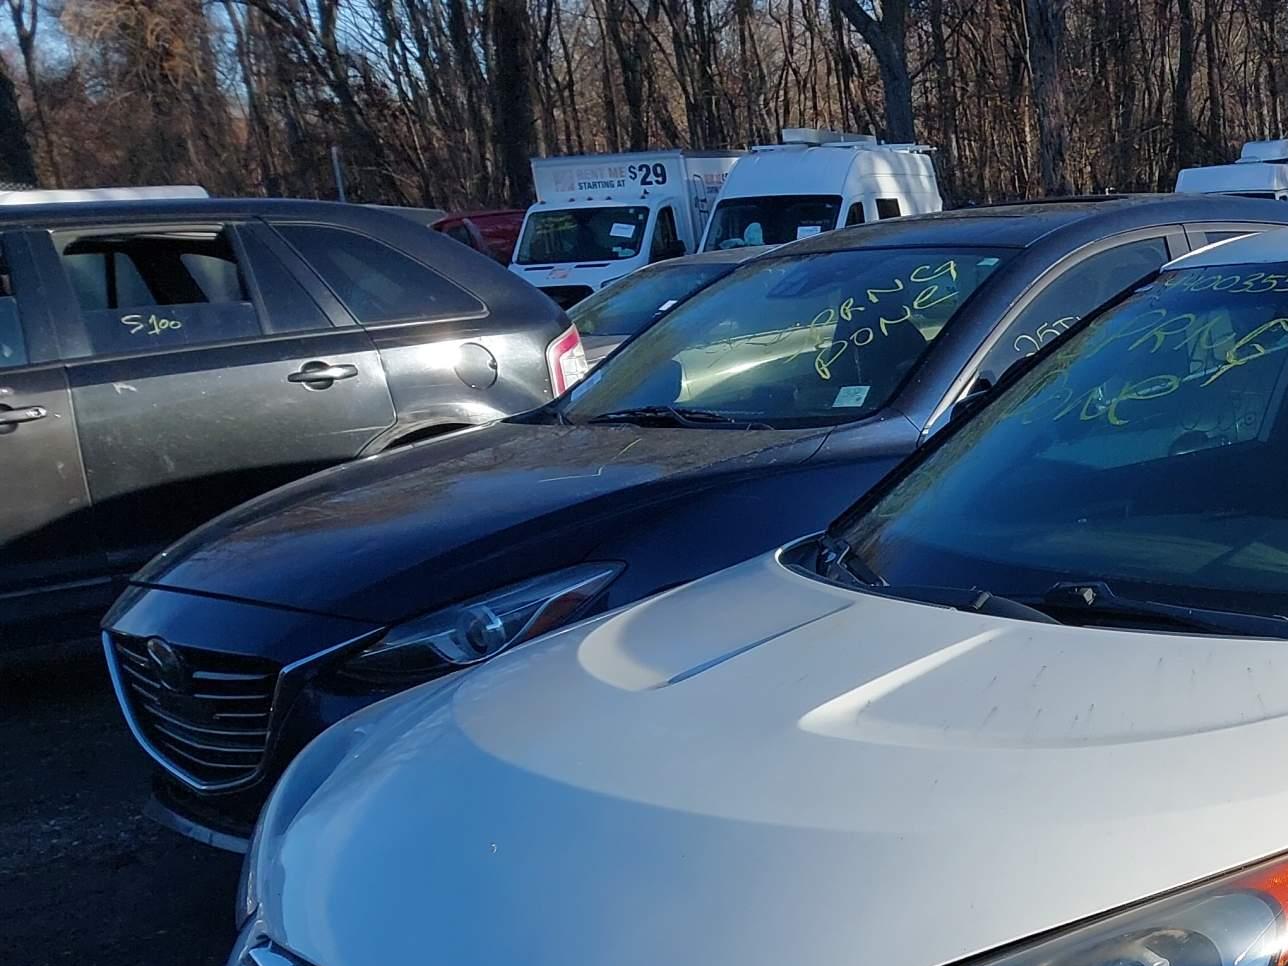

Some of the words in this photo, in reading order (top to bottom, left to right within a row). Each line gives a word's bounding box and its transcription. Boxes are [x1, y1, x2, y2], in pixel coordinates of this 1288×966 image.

[628, 162, 667, 186] $29
[578, 180, 615, 191] STARTING
[616, 179, 626, 189] AT
